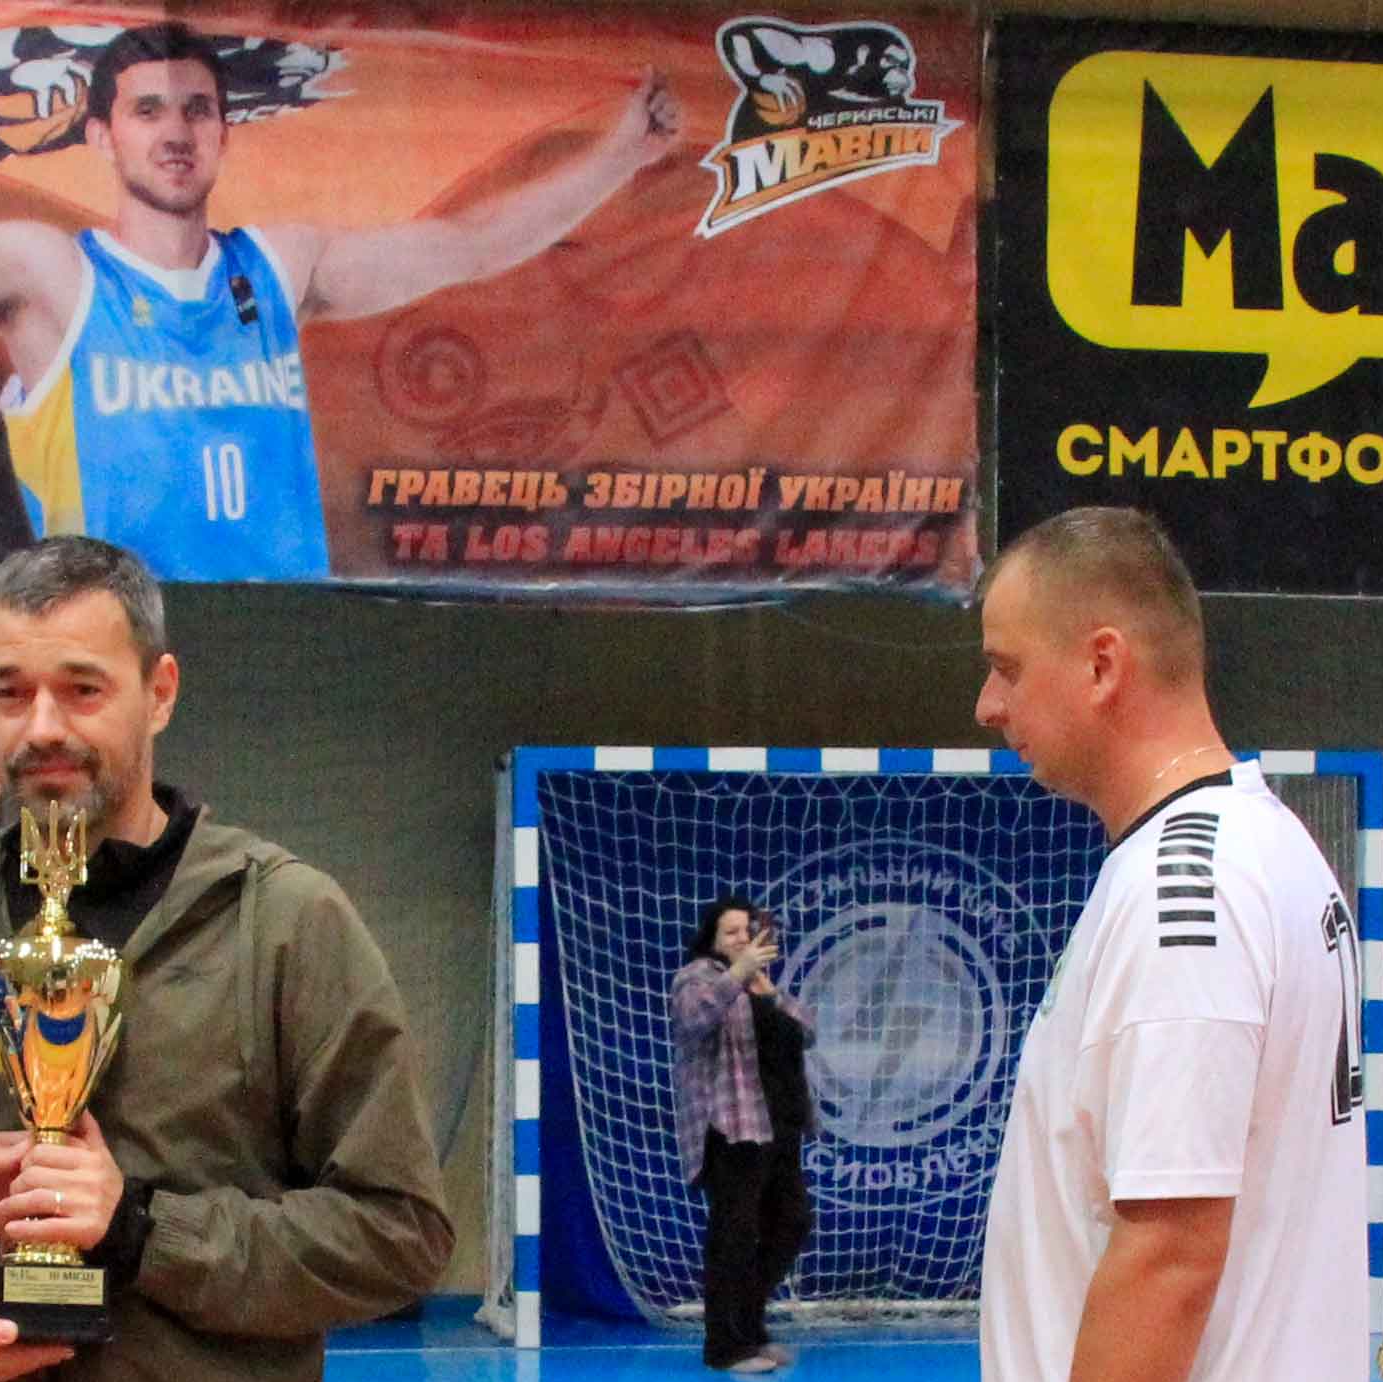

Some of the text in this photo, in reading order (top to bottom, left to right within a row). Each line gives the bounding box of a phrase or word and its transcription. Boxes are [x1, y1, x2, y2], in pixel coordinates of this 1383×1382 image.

[91, 351, 307, 416] UKRAINE
[202, 442, 246, 522] 10
[368, 466, 963, 513] ГРАВЕЦЬ ЗБІРНОЇ УКРАЇНИ
[392, 523, 450, 562] ТА
[464, 524, 550, 562] LOS
